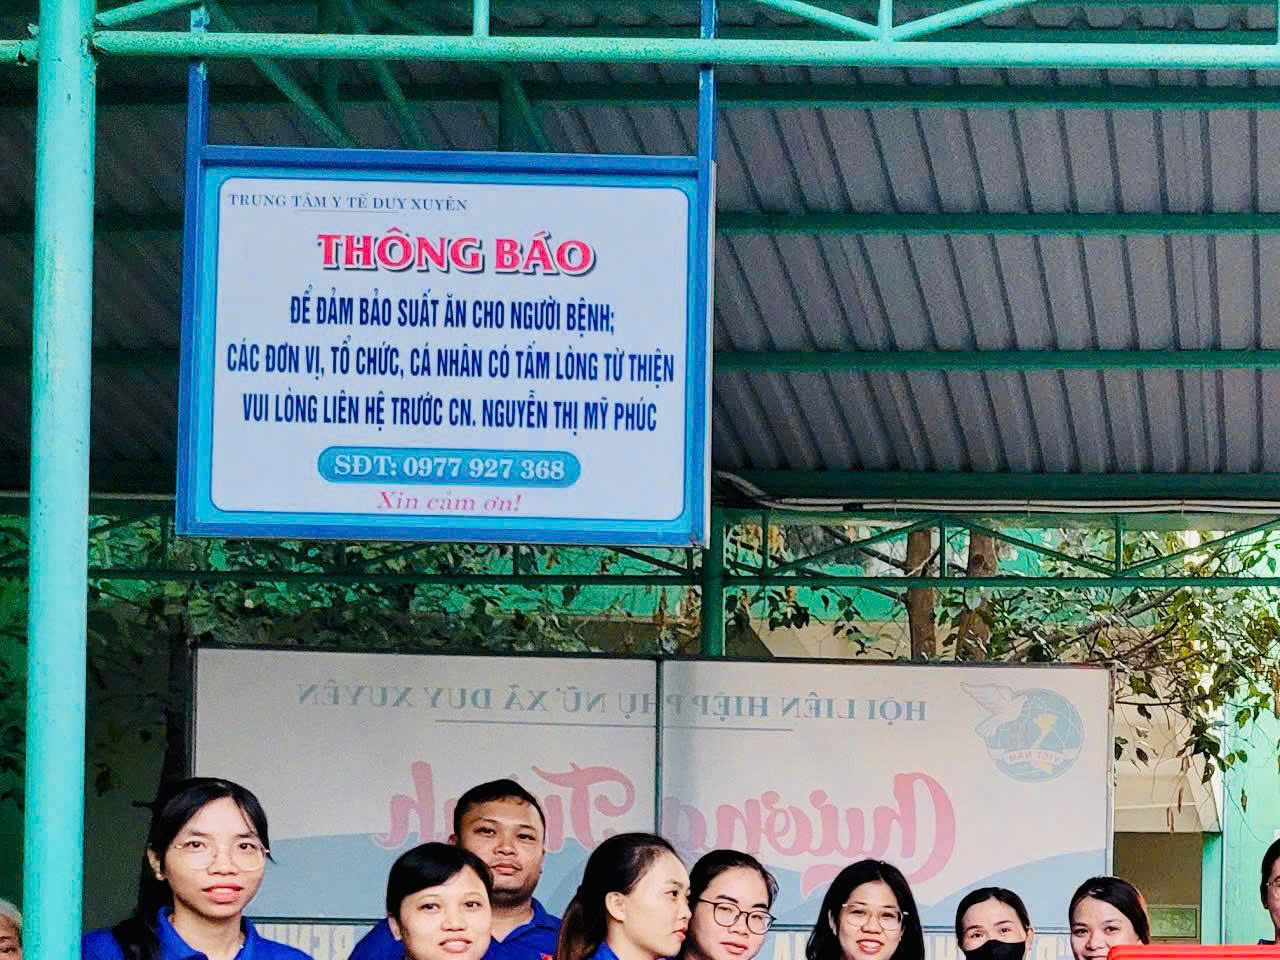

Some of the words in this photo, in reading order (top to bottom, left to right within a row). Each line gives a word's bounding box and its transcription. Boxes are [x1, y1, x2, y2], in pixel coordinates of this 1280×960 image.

[229, 194, 288, 209] TRUNG
[294, 192, 327, 209] TÂM
[331, 195, 342, 209] Y
[346, 191, 368, 209] TẾ
[371, 195, 407, 210] DUY
[411, 195, 468, 211] XUYÊN
[317, 227, 485, 274] THÔNG
[496, 231, 596, 277] BÁO
[290, 285, 312, 324] ĐỂ
[317, 287, 353, 325] ĐẢM
[360, 288, 391, 326] BẢO
[398, 289, 439, 327] SUẤT
[444, 294, 466, 328] ĂN
[472, 300, 504, 328] CHO
[511, 296, 560, 330] NGƯỜI
[567, 297, 614, 337] BỆNH;
[227, 338, 259, 372] CÁC
[265, 342, 299, 373] ĐƠN
[304, 346, 324, 380] VỊ,
[331, 335, 351, 374] TỔ
[356, 342, 403, 378] CHỨC,
[410, 343, 431, 376] CÁ
[437, 344, 482, 377] NHÂN
[488, 344, 510, 378] CÓ
[516, 341, 550, 379] TẤM
[556, 345, 598, 381] LÒNG
[604, 348, 624, 382] TỪ
[628, 348, 674, 388] THIỆN
[243, 394, 268, 421] VUI
[275, 388, 317, 423] LÒNG
[324, 390, 360, 424] LIÊN
[365, 391, 385, 431] HỆ
[391, 392, 442, 425] TRƯỚC
[449, 398, 475, 426] CN.
[482, 390, 548, 429] NGUYỄN
[553, 400, 578, 436] THỊ
[584, 397, 608, 430] MỸ
[614, 397, 656, 432] PHÚC
[335, 454, 398, 476] SĐT:
[402, 456, 463, 478] 0977
[468, 458, 515, 479] 927
[520, 459, 565, 480] 368
[377, 491, 418, 511] Xin
[424, 490, 478, 512] cảm
[482, 492, 522, 513] ơn!
